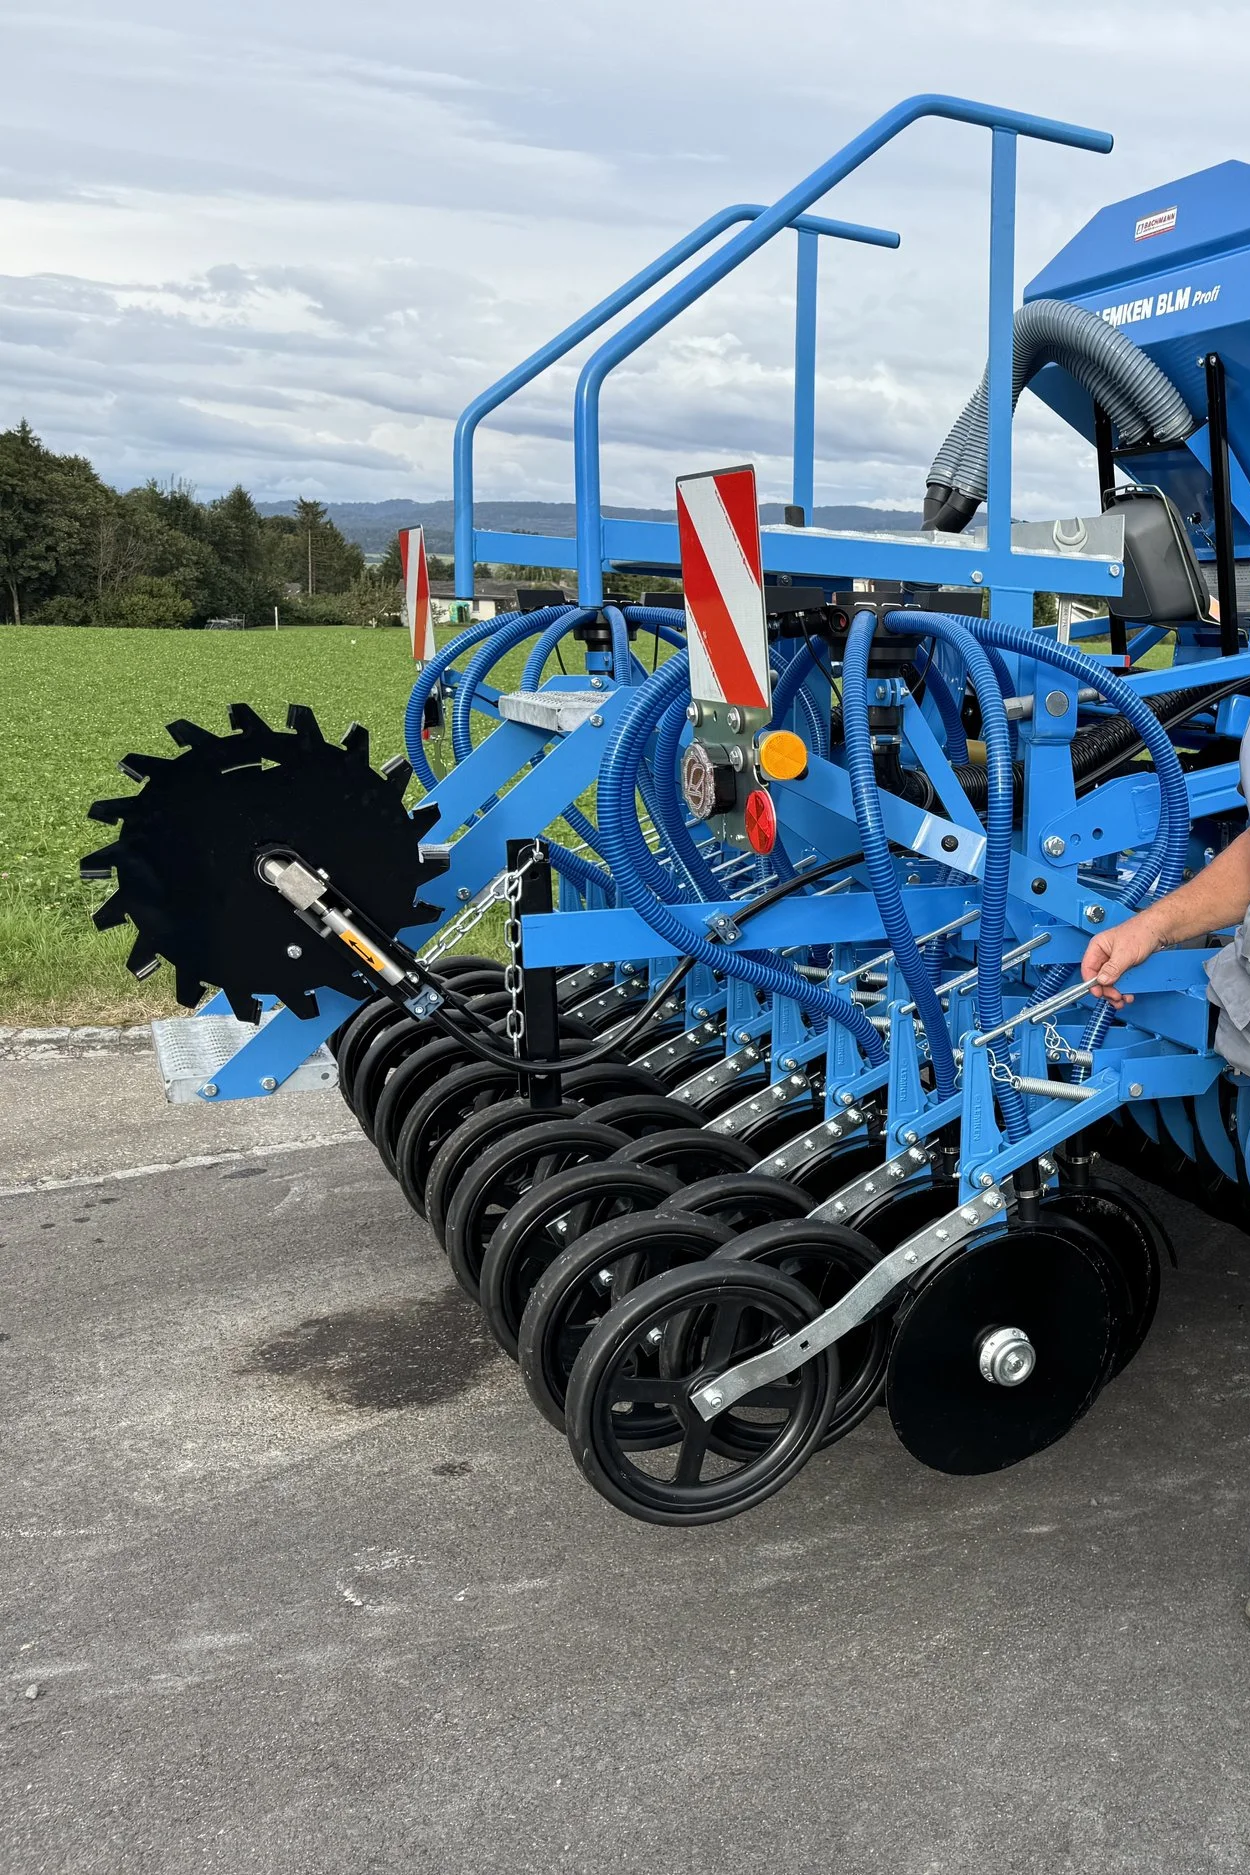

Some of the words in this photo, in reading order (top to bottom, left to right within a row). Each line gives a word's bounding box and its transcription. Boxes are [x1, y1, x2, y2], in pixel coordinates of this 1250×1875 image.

[1096, 296, 1154, 328] EMKEN
[1155, 286, 1191, 316] BLM
[1192, 285, 1221, 307] Profi
